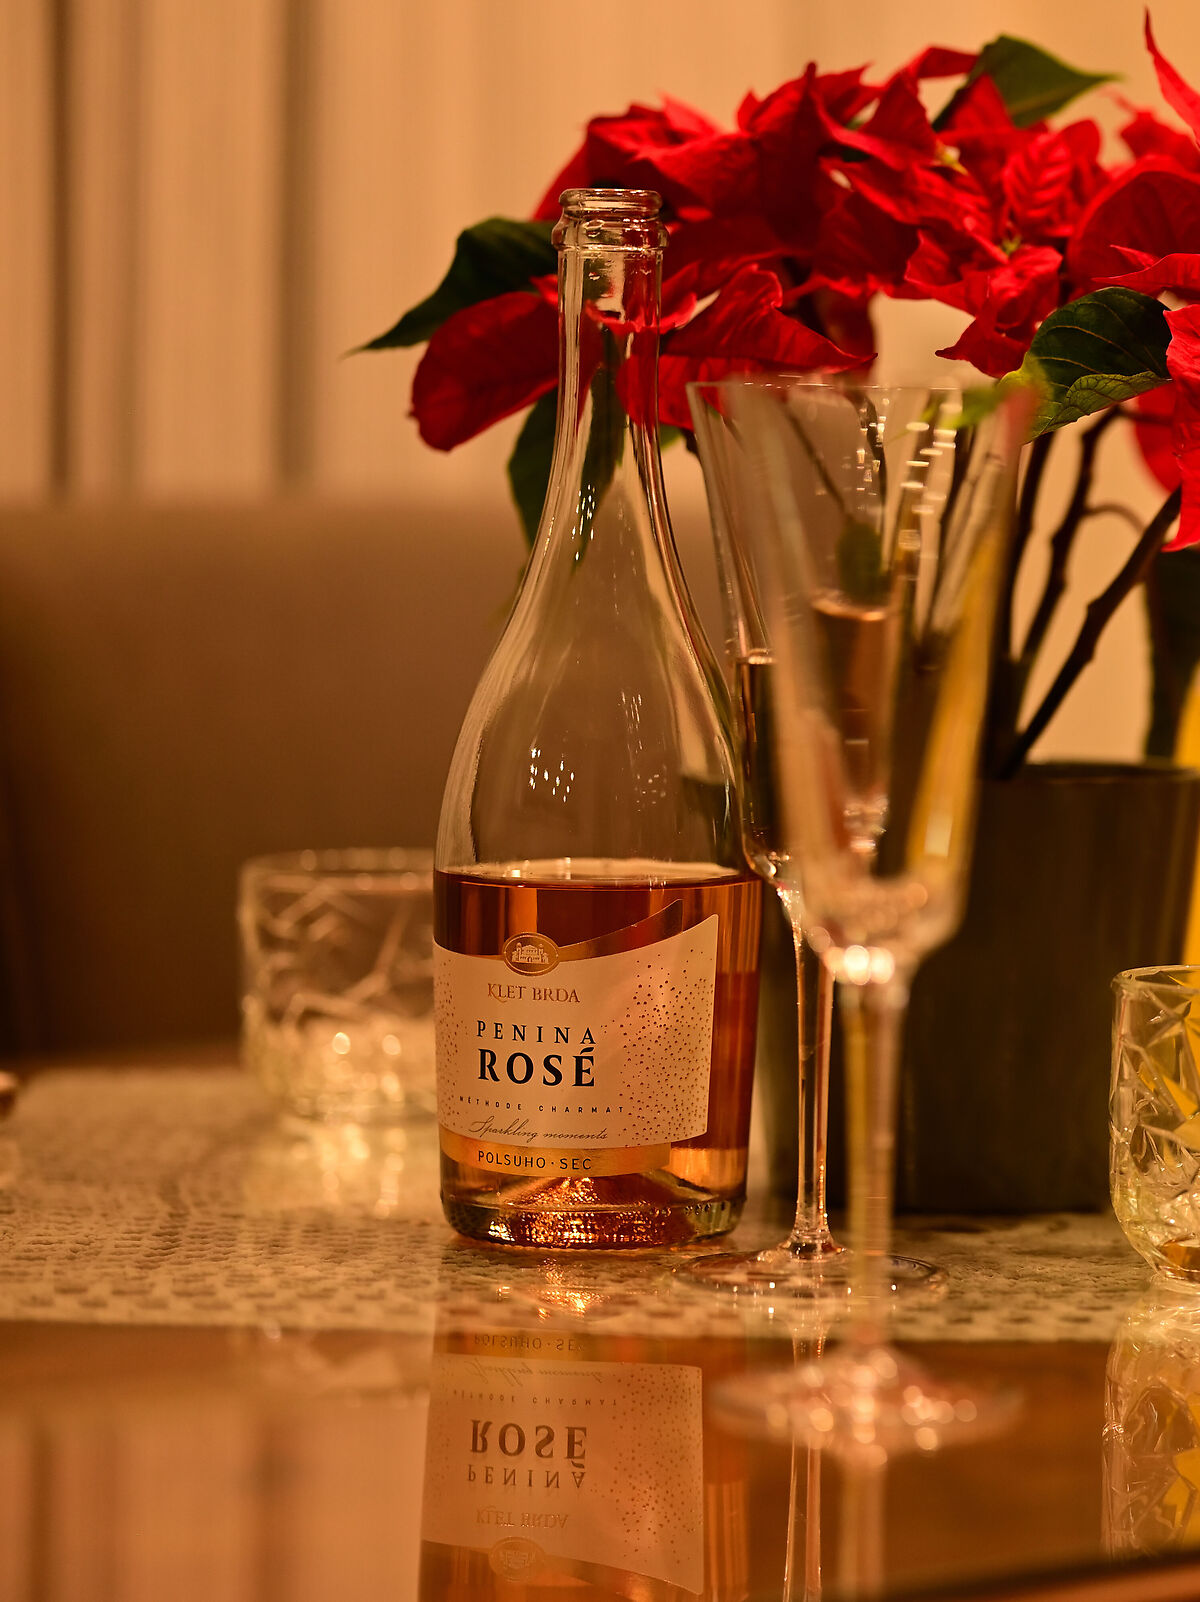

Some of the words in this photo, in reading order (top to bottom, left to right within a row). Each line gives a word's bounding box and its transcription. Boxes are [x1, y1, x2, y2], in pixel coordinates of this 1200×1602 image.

[487, 983, 526, 1003] KLET
[532, 986, 580, 1003] BRDA
[476, 1020, 597, 1045] PENINA
[478, 1046, 596, 1087] ROSÉ
[538, 1105, 624, 1114] CHARMAT
[468, 1115, 538, 1143] Sparkling
[542, 1127, 608, 1141] moments
